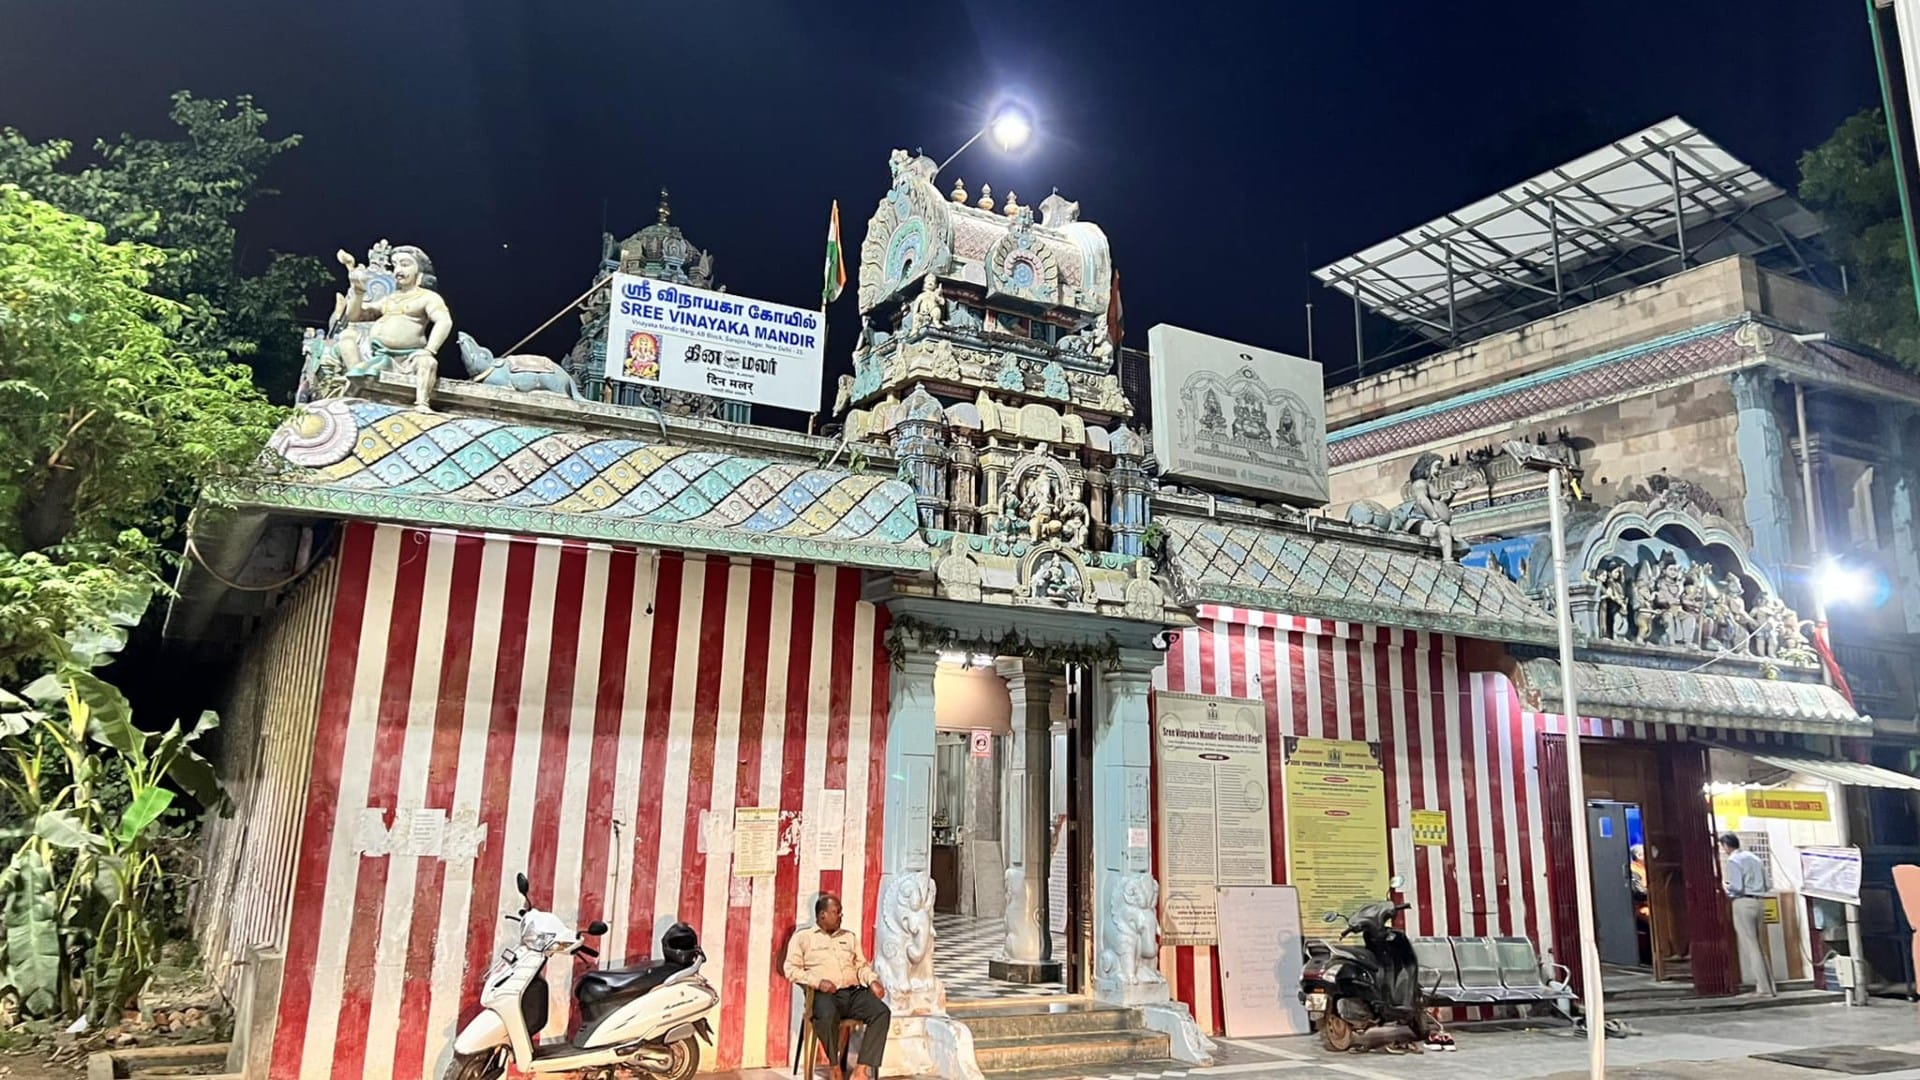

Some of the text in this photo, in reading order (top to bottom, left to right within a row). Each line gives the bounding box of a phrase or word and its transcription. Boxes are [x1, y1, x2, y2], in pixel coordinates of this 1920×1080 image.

[657, 286, 744, 317] விநாயகா
[748, 304, 817, 330] கோயில்
[620, 301, 816, 349] SREE VINAYAKA MANDIR
[706, 372, 726, 387] दिन
[1163, 727, 1175, 737] Sree
[1218, 731, 1244, 743] Committee
